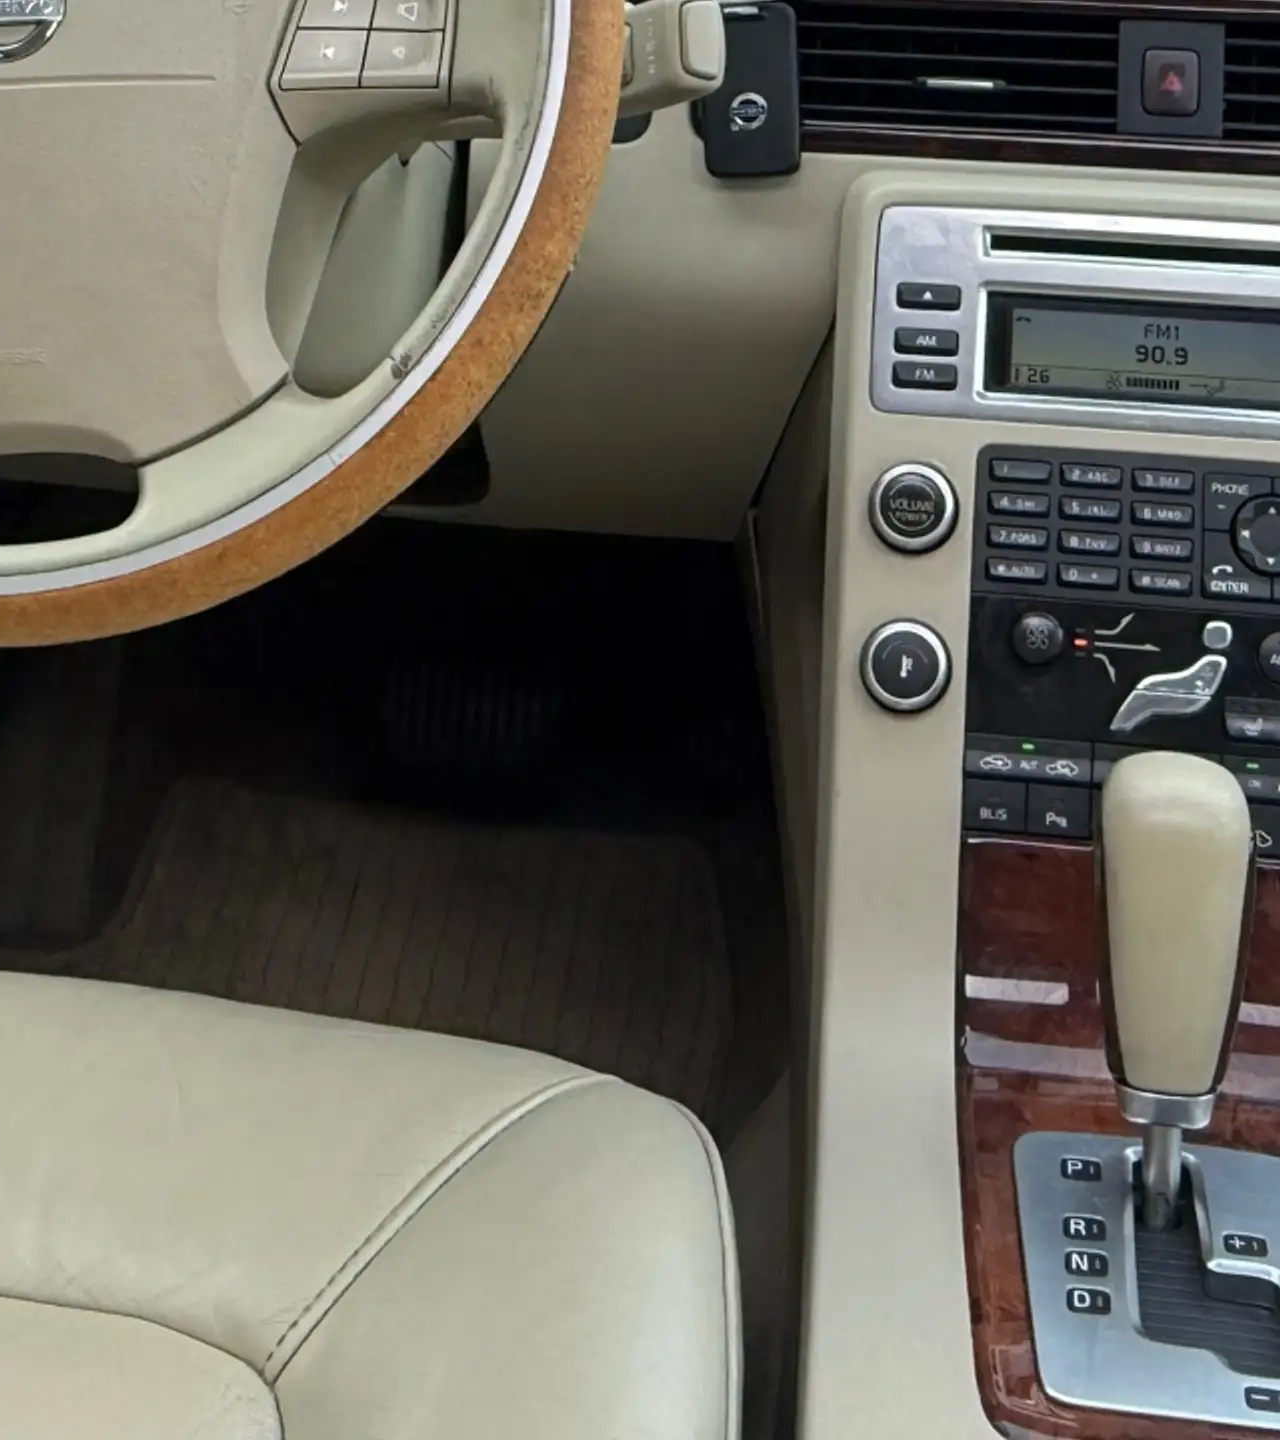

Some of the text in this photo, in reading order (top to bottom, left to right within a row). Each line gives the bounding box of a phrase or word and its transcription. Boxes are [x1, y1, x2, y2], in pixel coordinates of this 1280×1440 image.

[915, 334, 938, 346] AM
[1143, 324, 1181, 341] FM1
[1135, 344, 1189, 366] 90.9
[914, 367, 936, 381] FM
[1211, 482, 1250, 496] PHONE
[1210, 580, 1250, 594] ENTER
[979, 806, 1008, 821] BLIS
[1066, 1160, 1083, 1175] P
[1069, 1219, 1087, 1236] R
[1071, 1253, 1089, 1272] N
[1073, 1289, 1092, 1308] D
